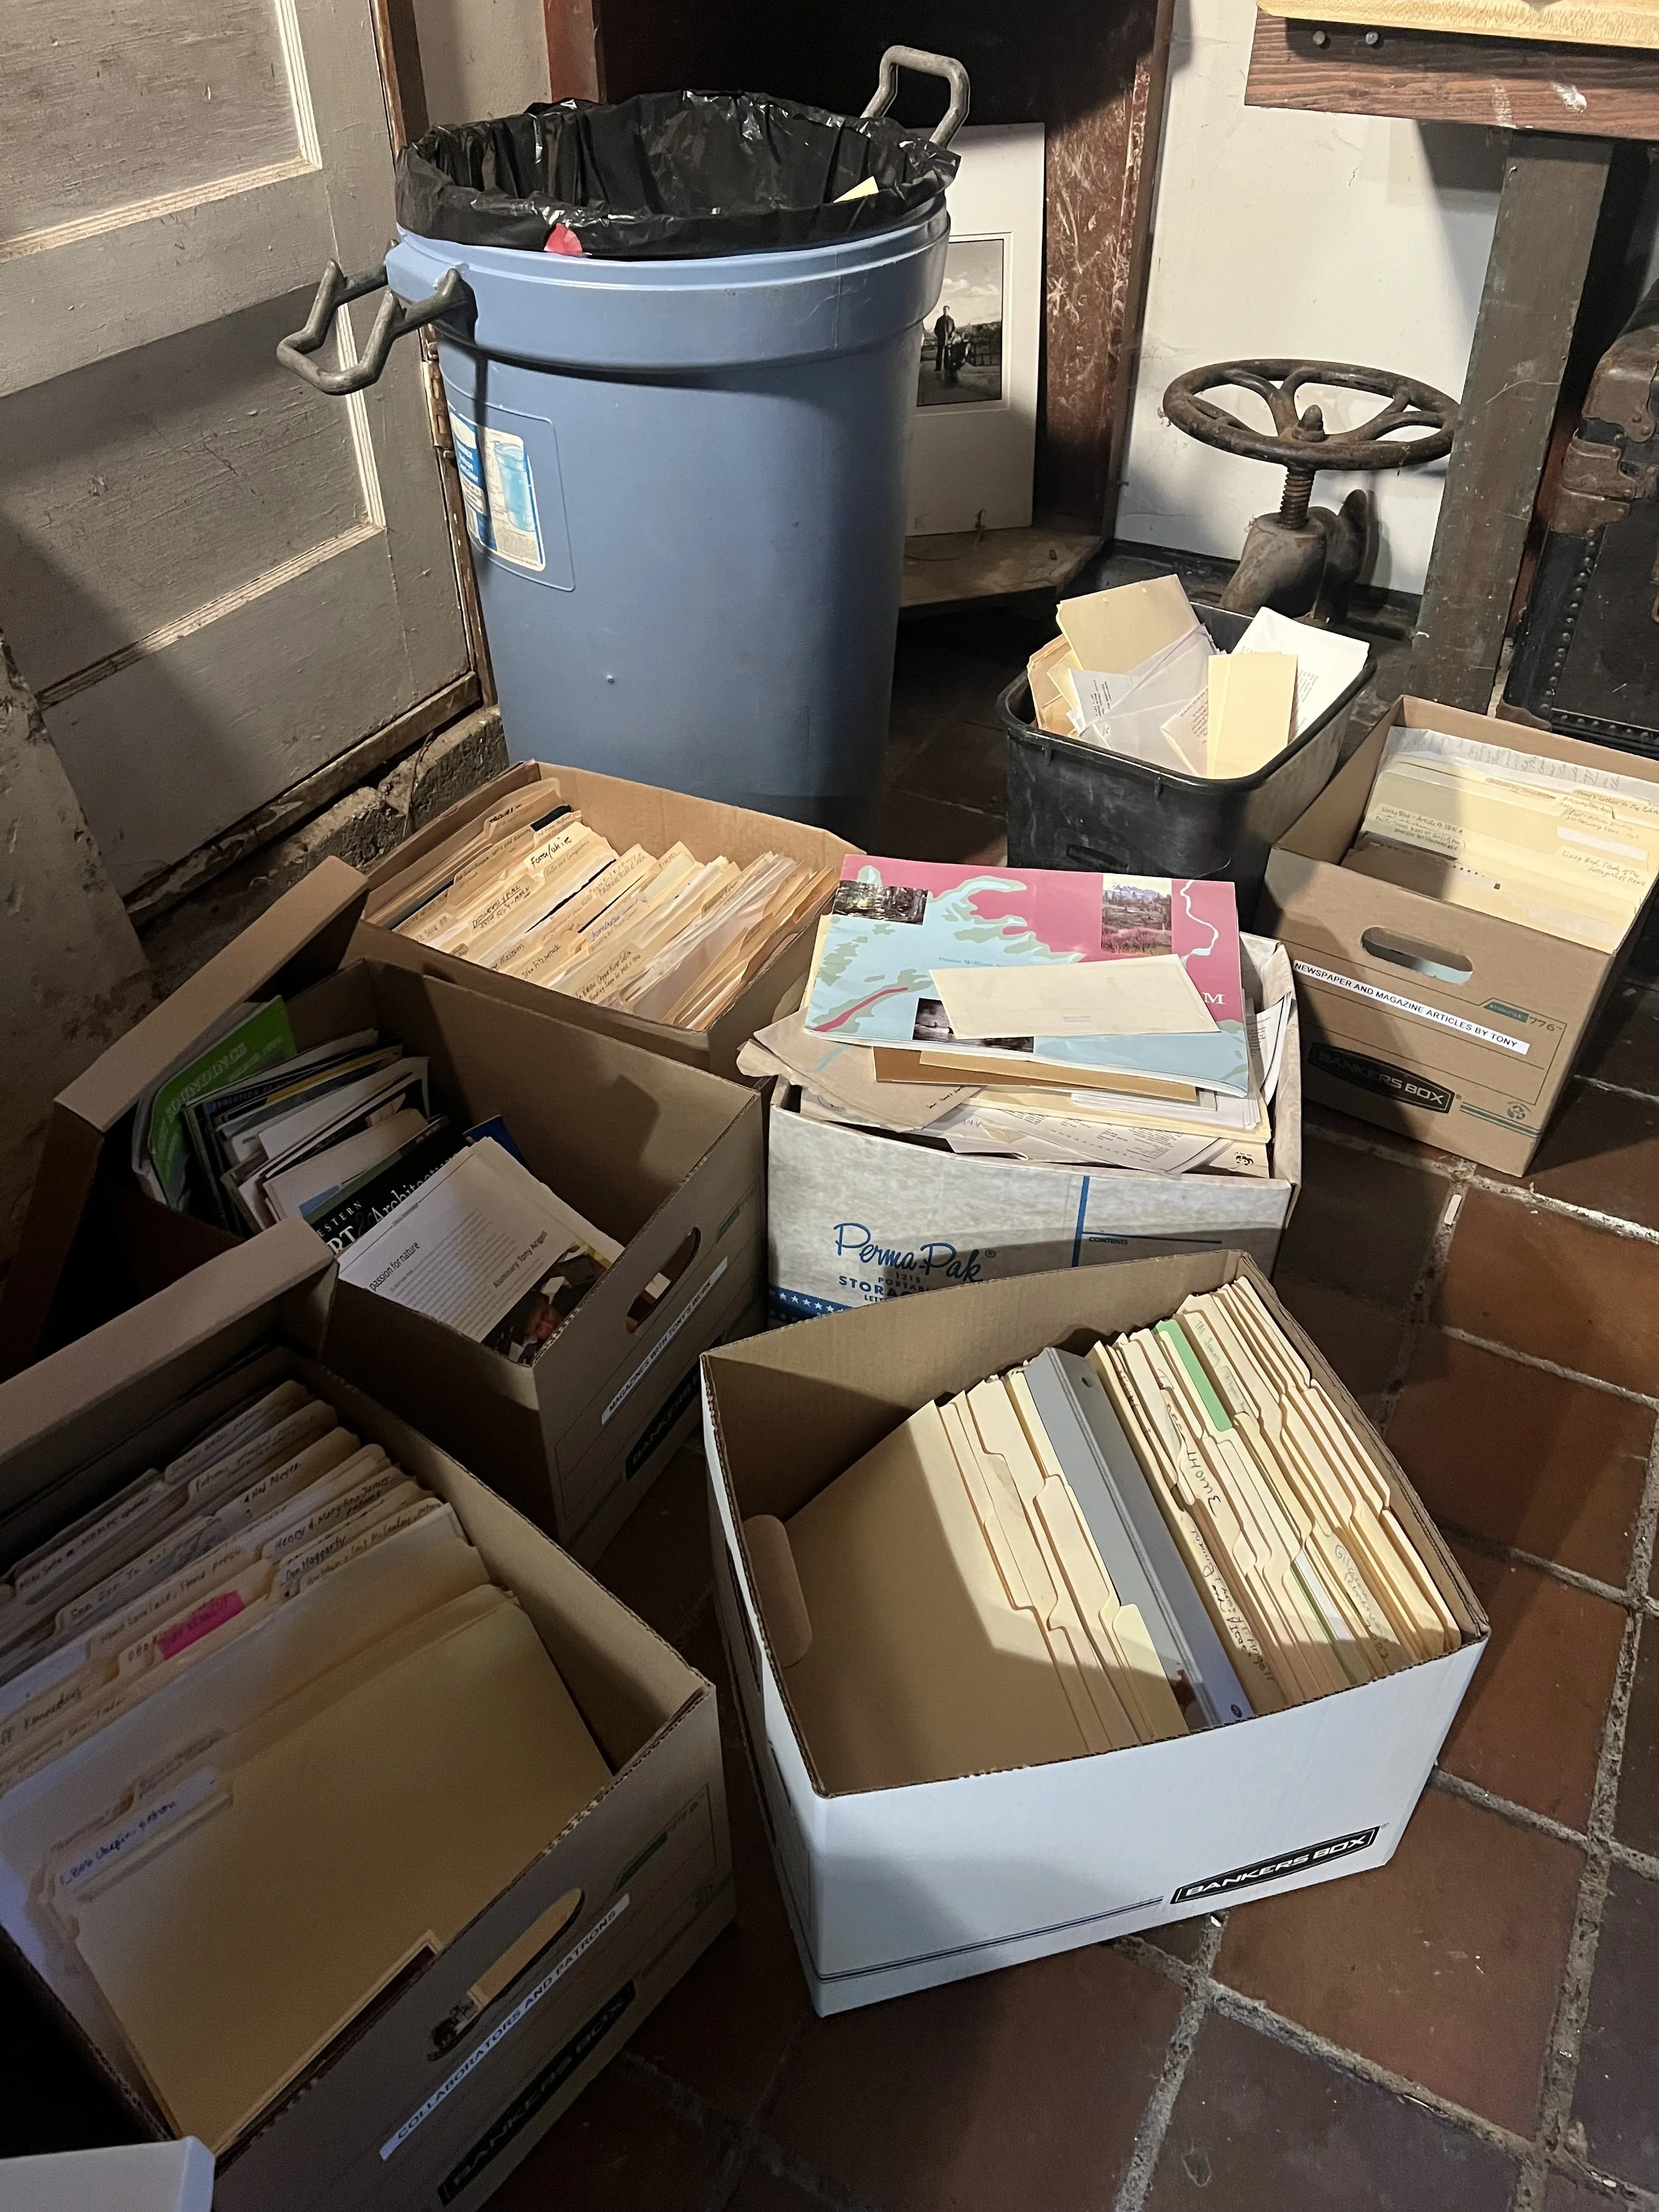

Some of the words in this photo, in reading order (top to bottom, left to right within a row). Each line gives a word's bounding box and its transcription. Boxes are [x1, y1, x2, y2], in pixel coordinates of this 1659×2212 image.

[1293, 961, 1352, 988] NEWSPAPER
[1354, 983, 1374, 995] AND
[1375, 990, 1424, 1014] MAGAZINE
[1425, 1008, 1473, 1032] ARTICLES
[1474, 1026, 1488, 1037] BY
[1489, 1032, 1518, 1049] TONY
[1404, 1081, 1445, 1105] BOX
[317, 1200, 362, 1238] ESTERN
[326, 1224, 360, 1256] RT
[1088, 1236, 1129, 1244] CONTENTS
[369, 1266, 394, 1291] passion
[389, 1258, 401, 1270] for
[399, 1242, 420, 1262] nature
[833, 1222, 983, 1282] Perma-Pak
[878, 1277, 930, 1291] PORTAB
[607, 1359, 651, 1412] MAGAZINES
[648, 1336, 670, 1359] WITH
[668, 1305, 693, 1336] TONY'S
[691, 1281, 713, 1306] WORK
[271, 1524, 309, 1552] Henry
[1185, 1854, 1309, 1896] BANKERS
[1313, 1836, 1366, 1859] BOX
[396, 2008, 523, 2139] COLLABORATORS
[522, 1978, 553, 2008] AND
[555, 1909, 618, 1974] PATRONS
